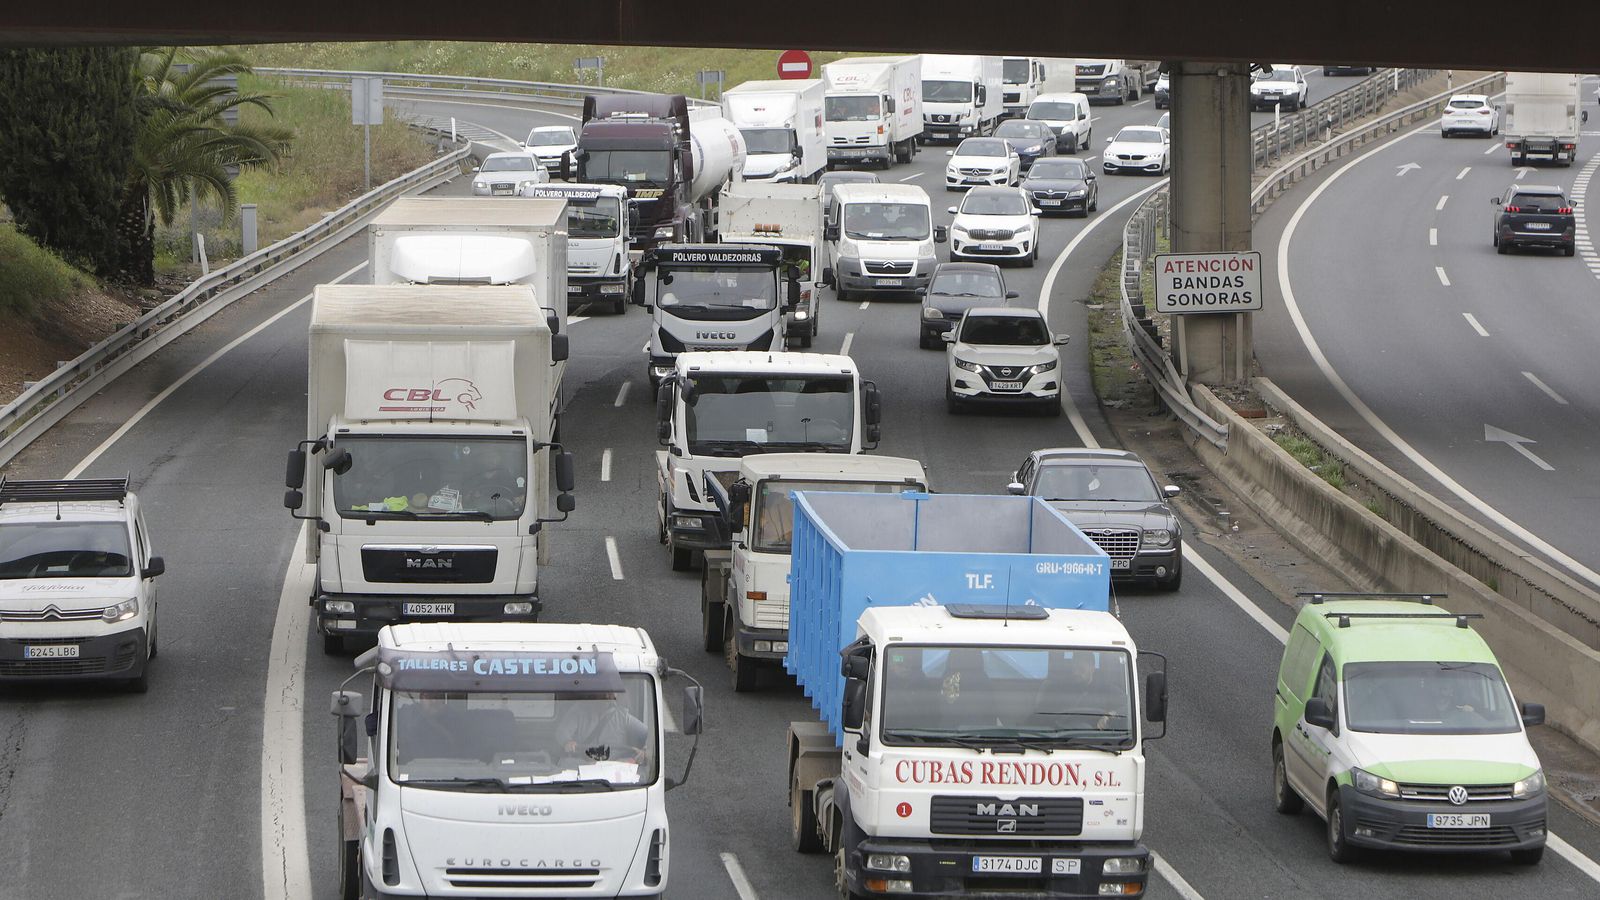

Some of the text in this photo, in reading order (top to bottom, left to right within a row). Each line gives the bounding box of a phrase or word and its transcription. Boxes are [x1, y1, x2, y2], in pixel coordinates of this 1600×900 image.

[535, 190, 563, 198] POLVERO
[673, 252, 762, 262] POLVERO VALDEZORRAS
[1164, 257, 1254, 273] ATENCIÓN
[1173, 276, 1244, 289] BANDAS
[1167, 291, 1253, 306] SONORAS
[696, 331, 736, 340] IVECO
[383, 388, 452, 402] CBL
[406, 559, 452, 568] MAN
[1112, 560, 1128, 568] FPC
[965, 573, 995, 590] TLF.
[409, 605, 453, 614] 4052 KHK
[30, 647, 76, 657] 6245 LBG
[398, 657, 597, 675] TALLERES CASTEJON
[895, 759, 1122, 790] CUBAS RENDON, S.L.
[498, 804, 553, 817] IVECO
[977, 803, 1038, 817] MAN
[1435, 816, 1488, 826] 9735 JPN
[446, 858, 601, 868] EUROCARGO
[981, 858, 1039, 871] 3174 DJC
[1055, 860, 1077, 873] SP
